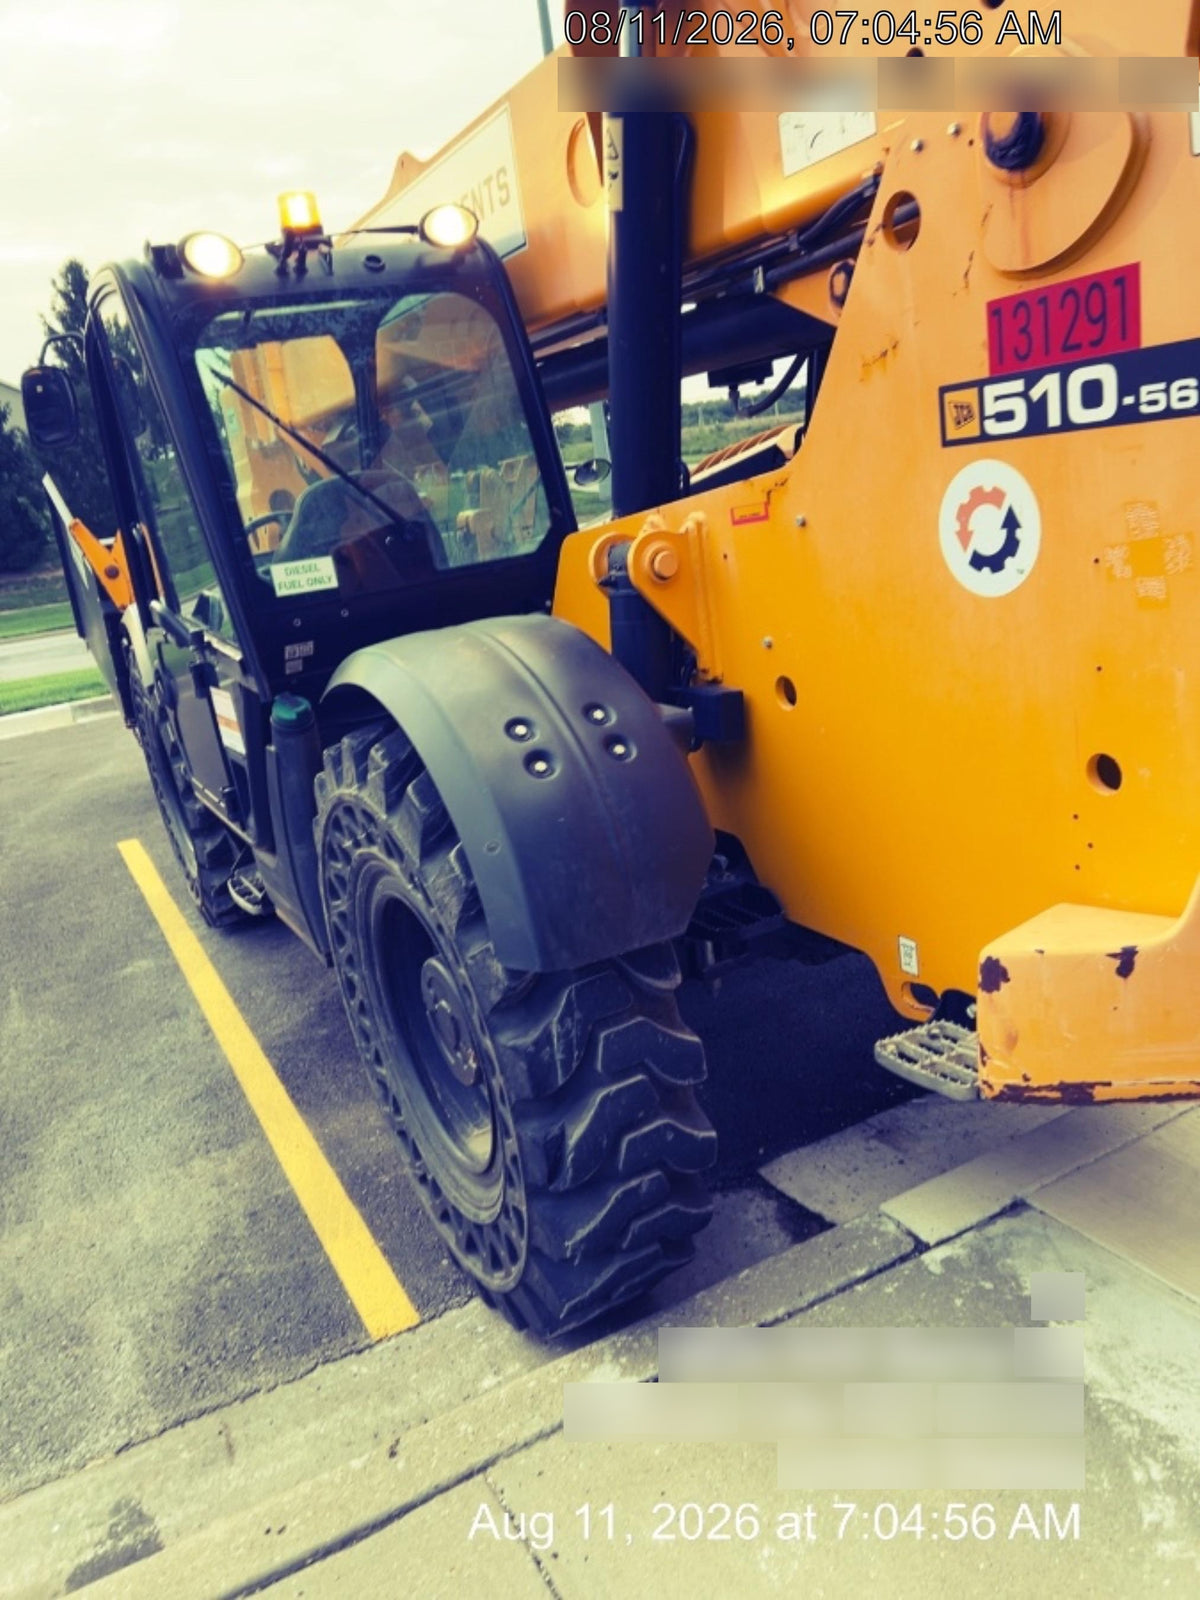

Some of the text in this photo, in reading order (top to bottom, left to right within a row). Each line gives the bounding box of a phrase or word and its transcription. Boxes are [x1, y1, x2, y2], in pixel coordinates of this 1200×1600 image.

[991, 275, 1127, 366] 131291
[284, 563, 320, 577] DIESEL
[278, 575, 332, 593] FUEL ONLY
